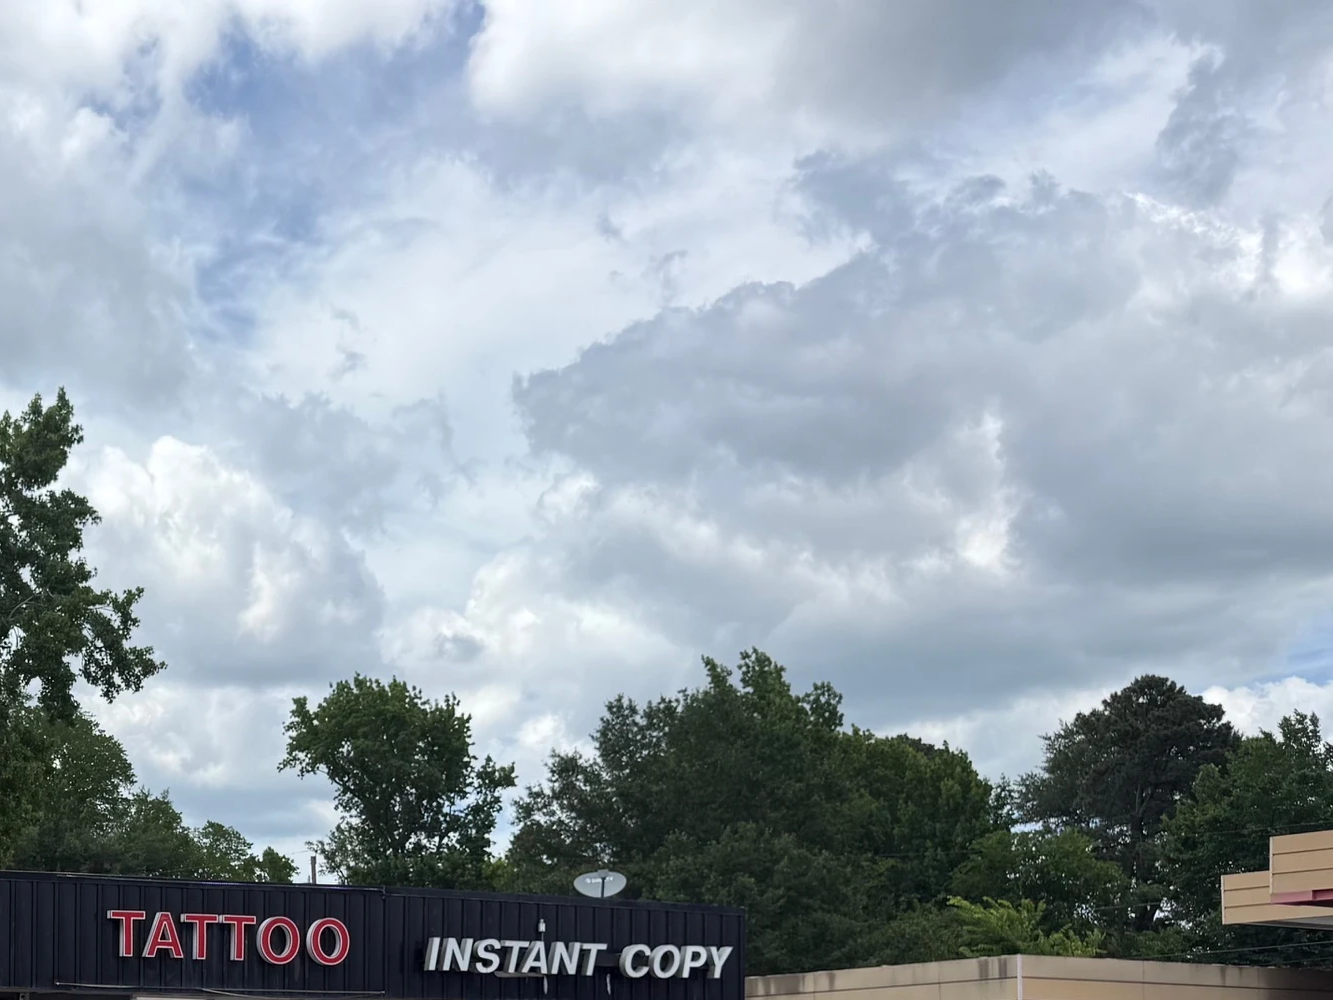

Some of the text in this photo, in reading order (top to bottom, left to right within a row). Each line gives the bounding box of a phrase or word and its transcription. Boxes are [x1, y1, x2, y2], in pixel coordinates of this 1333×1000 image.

[107, 910, 350, 966] TATTOO
[424, 937, 733, 979] INSTANT COPY
